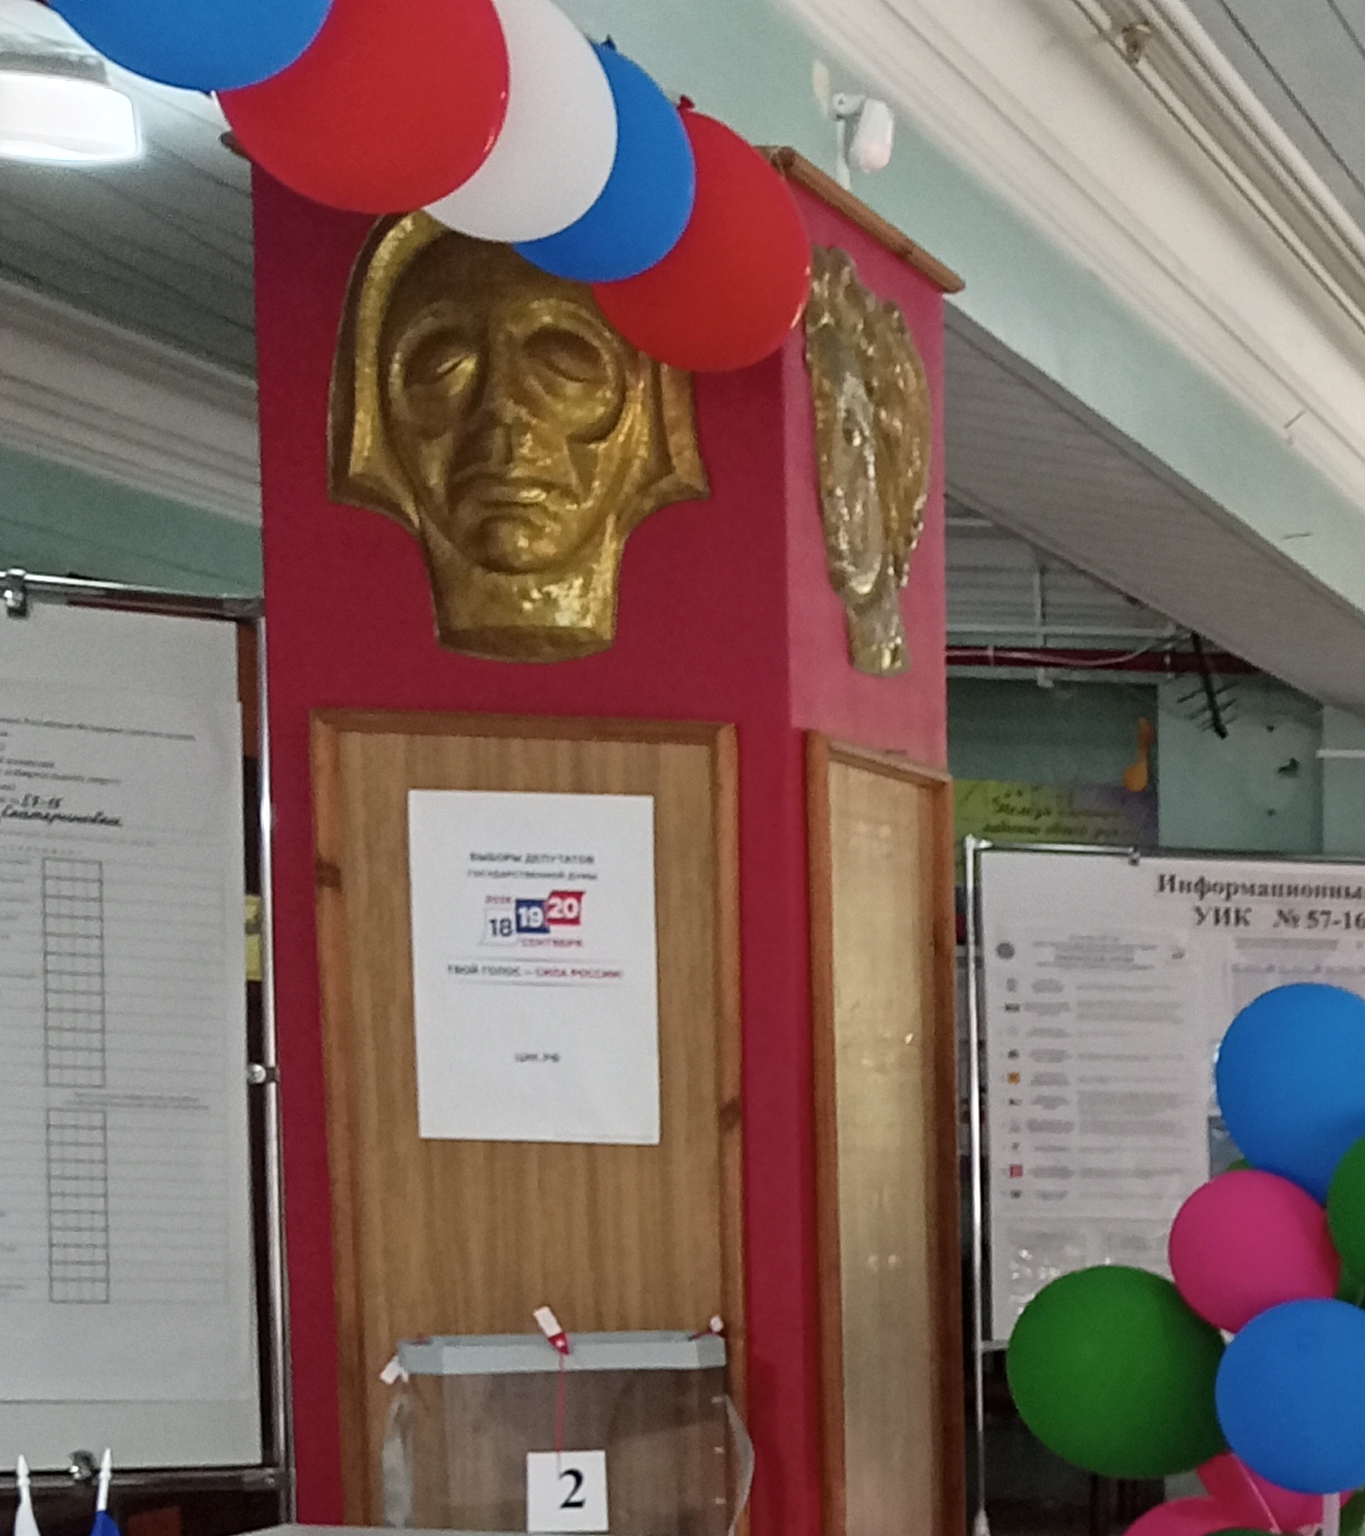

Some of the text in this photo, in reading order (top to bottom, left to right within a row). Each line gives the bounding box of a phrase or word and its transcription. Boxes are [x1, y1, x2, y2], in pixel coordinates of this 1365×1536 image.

[525, 853, 594, 864] ДЕПУТАТОВ
[489, 896, 579, 937] 18 19 20
[1194, 905, 1252, 927] УИК
[1273, 908, 1300, 929] №
[559, 1467, 586, 1509] 2
